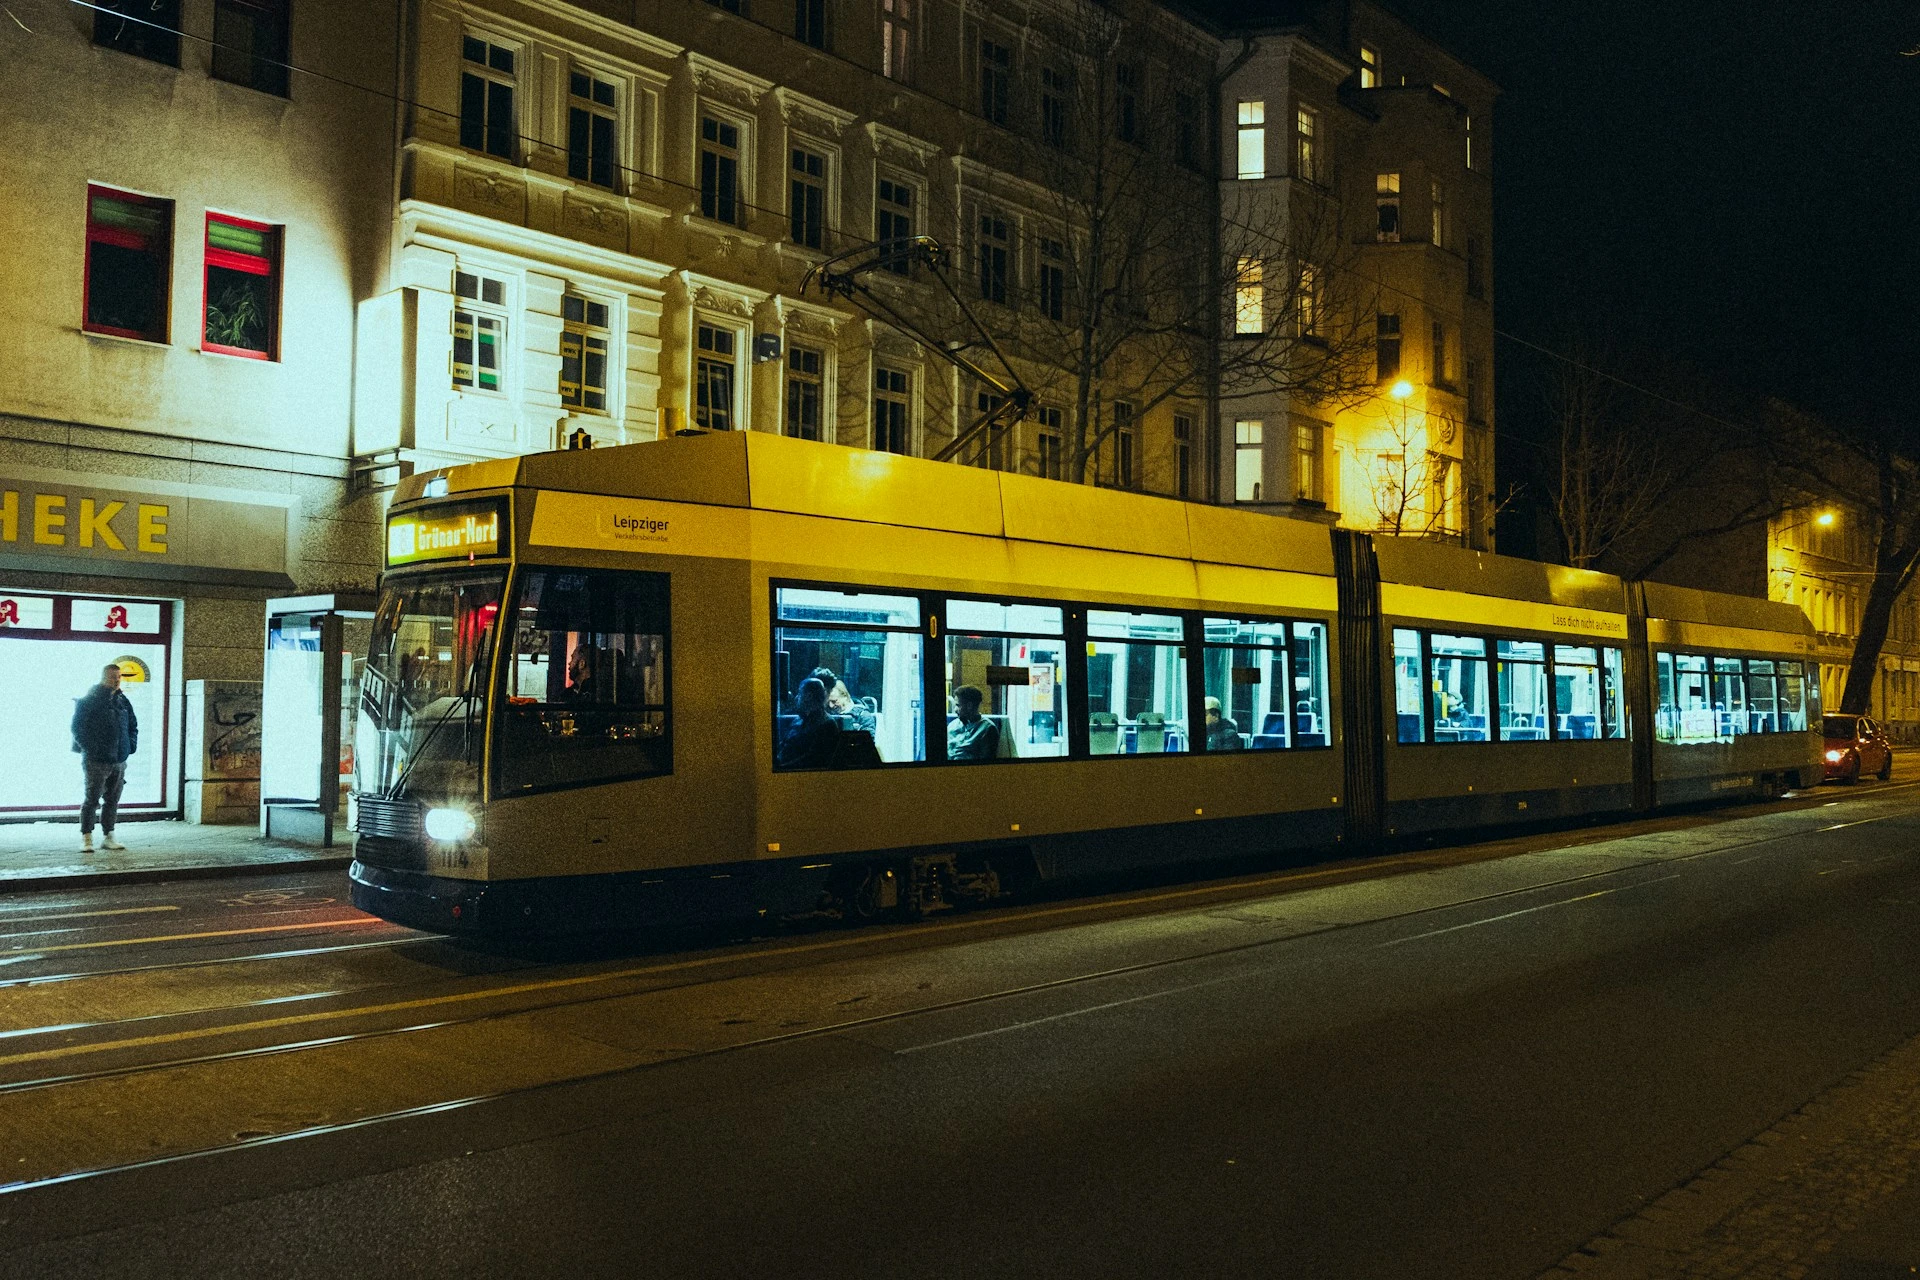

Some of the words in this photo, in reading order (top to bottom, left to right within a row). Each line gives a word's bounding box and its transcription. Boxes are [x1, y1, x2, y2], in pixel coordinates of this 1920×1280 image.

[418, 512, 498, 550] Grünau-Nord
[613, 513, 670, 534] Leipziger
[1552, 613, 1566, 626] Lass
[1567, 615, 1580, 628] dich
[1580, 617, 1595, 630] nicht
